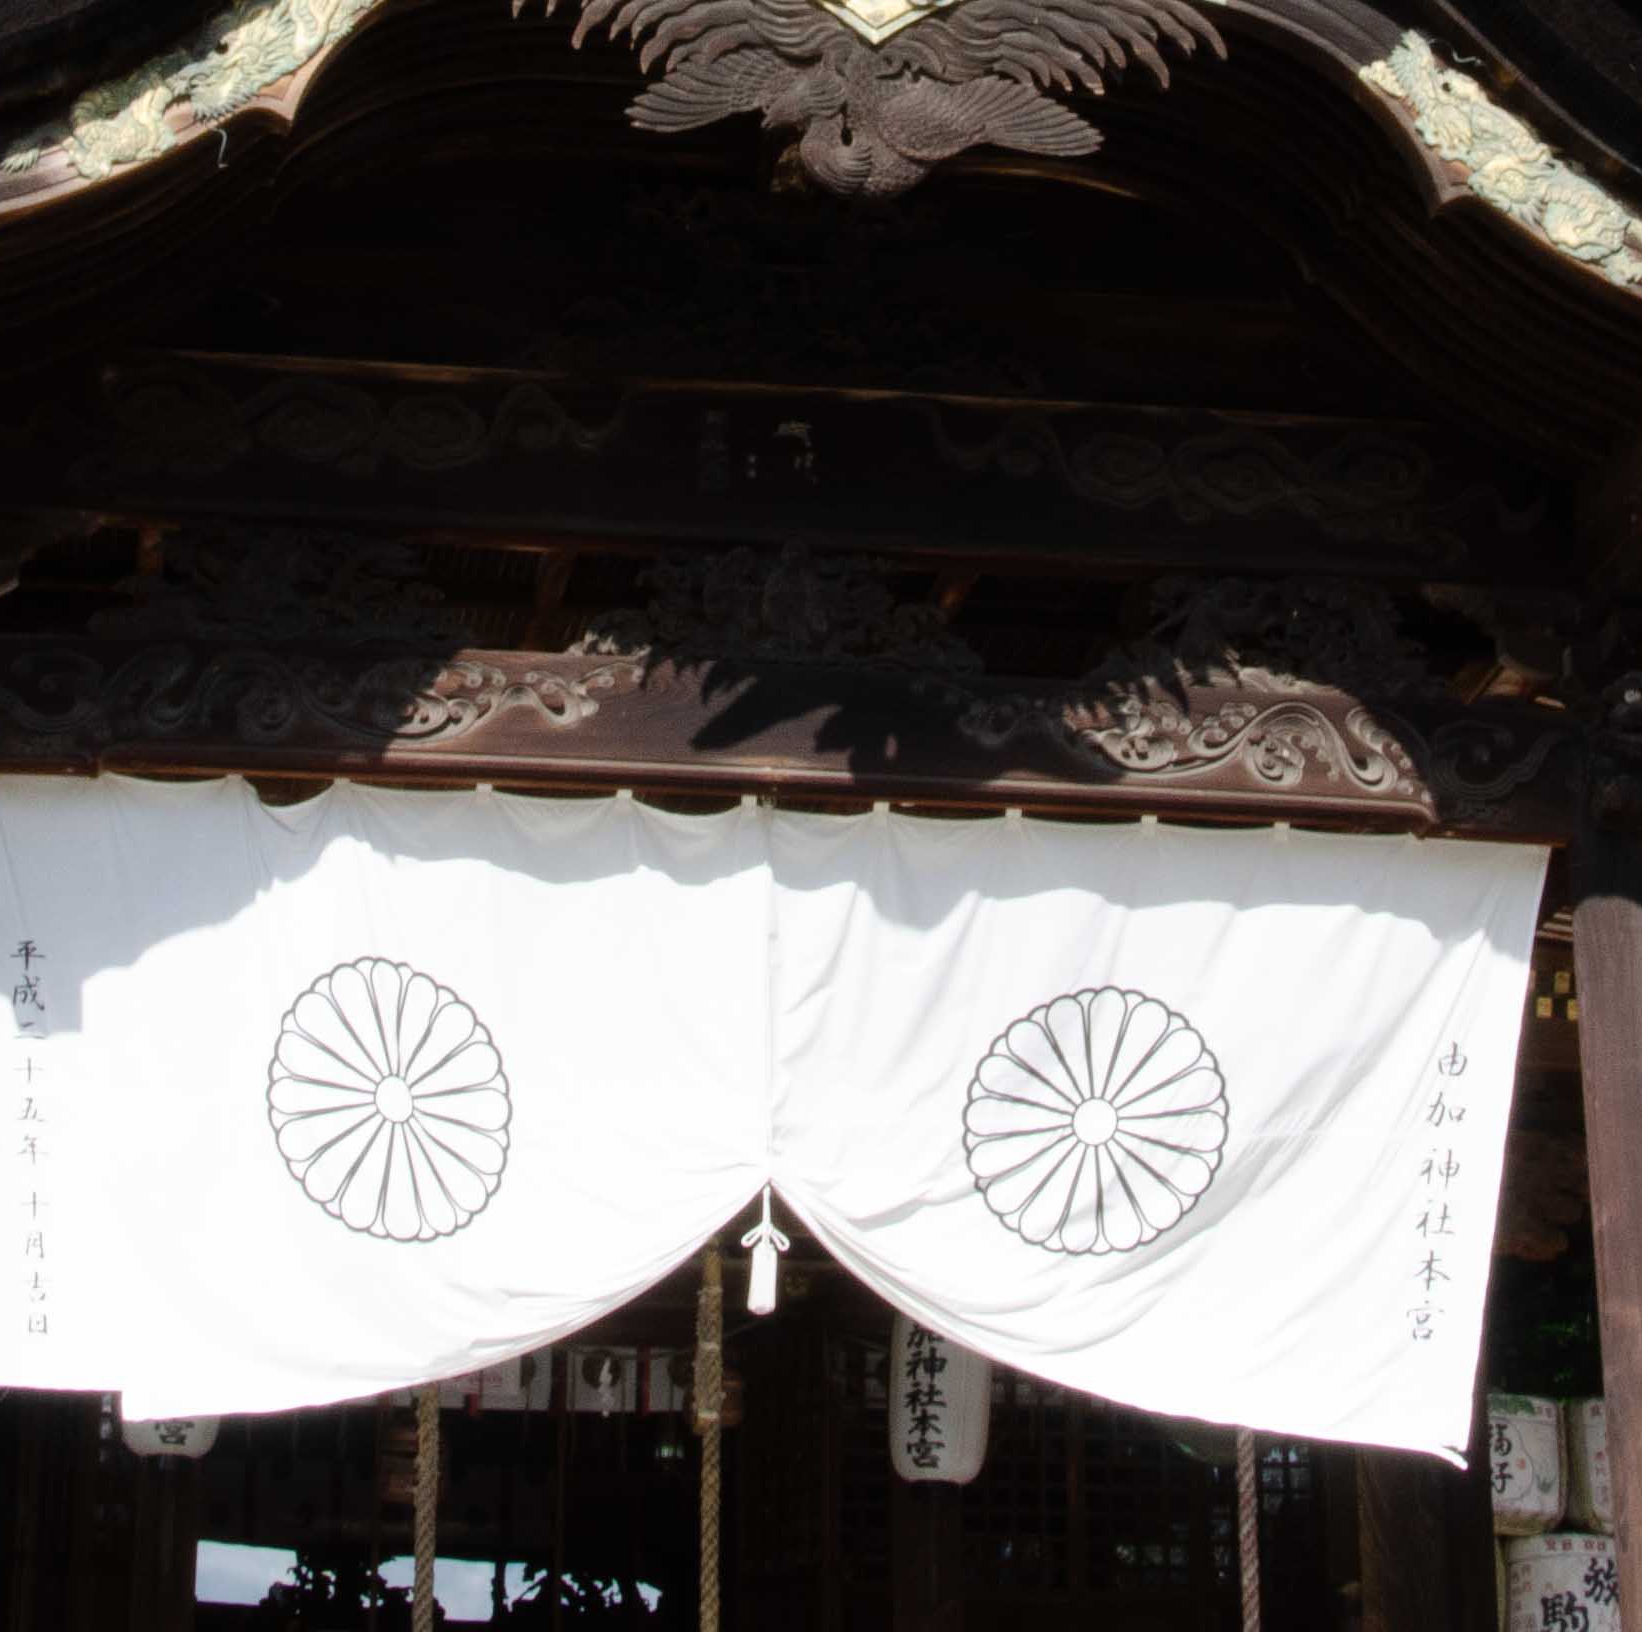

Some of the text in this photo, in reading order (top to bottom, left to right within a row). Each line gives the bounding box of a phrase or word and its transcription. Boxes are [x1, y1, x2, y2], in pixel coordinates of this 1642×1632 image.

[1404, 1042, 1467, 1343] 由加神社本宮
